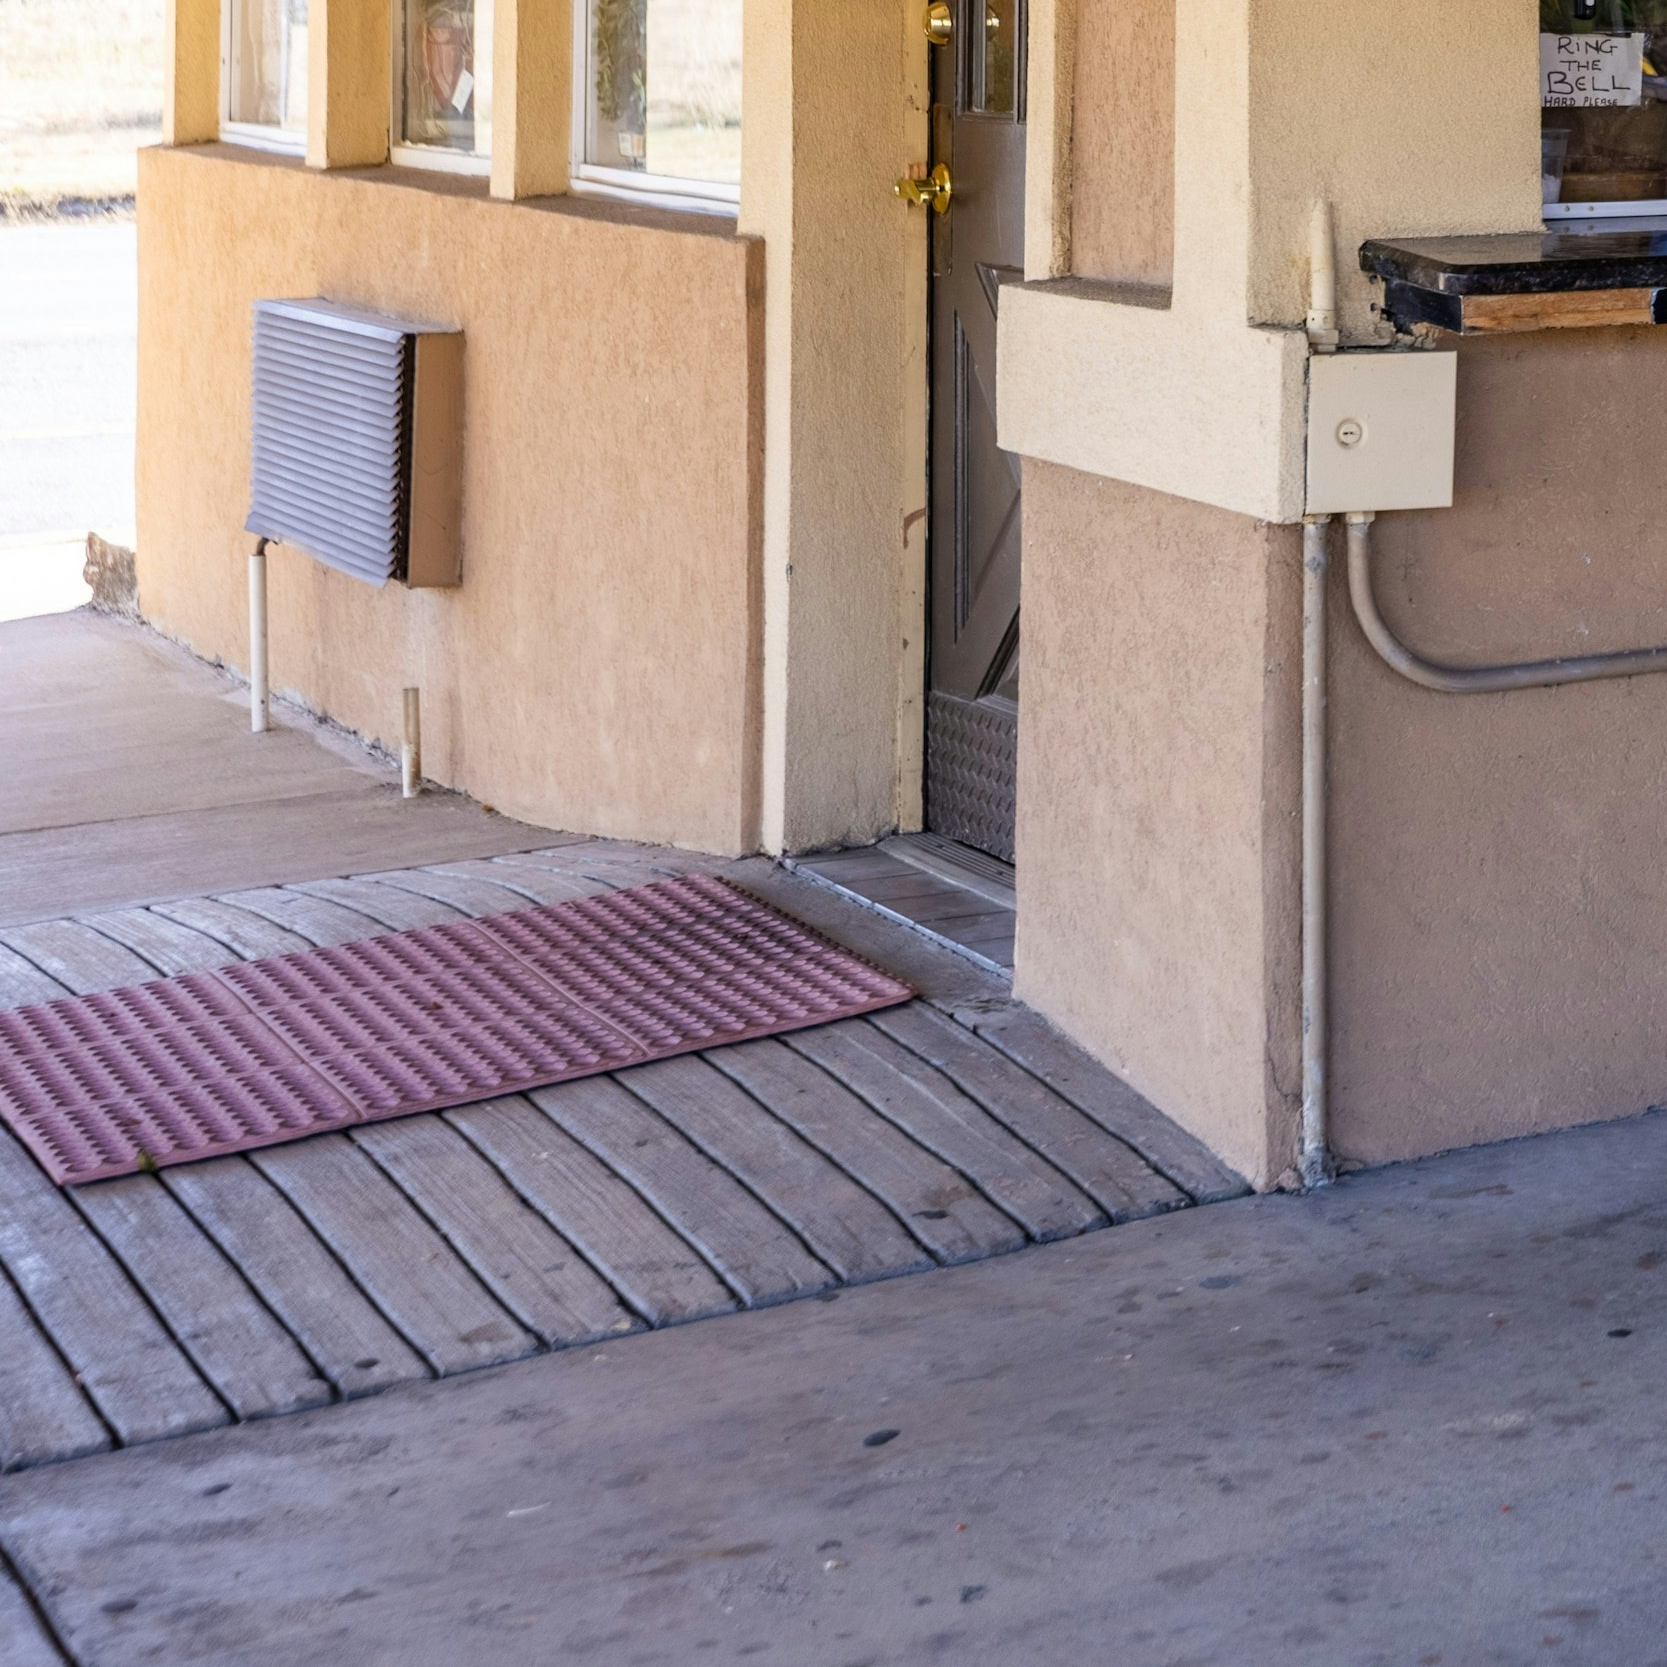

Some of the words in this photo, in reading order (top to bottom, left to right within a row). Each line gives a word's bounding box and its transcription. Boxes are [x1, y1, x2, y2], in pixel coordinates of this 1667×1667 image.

[1560, 60, 1602, 72] THE
[1547, 71, 1631, 94] BELL
[1545, 95, 1576, 108] HARD
[1583, 96, 1618, 107] PLEASE
